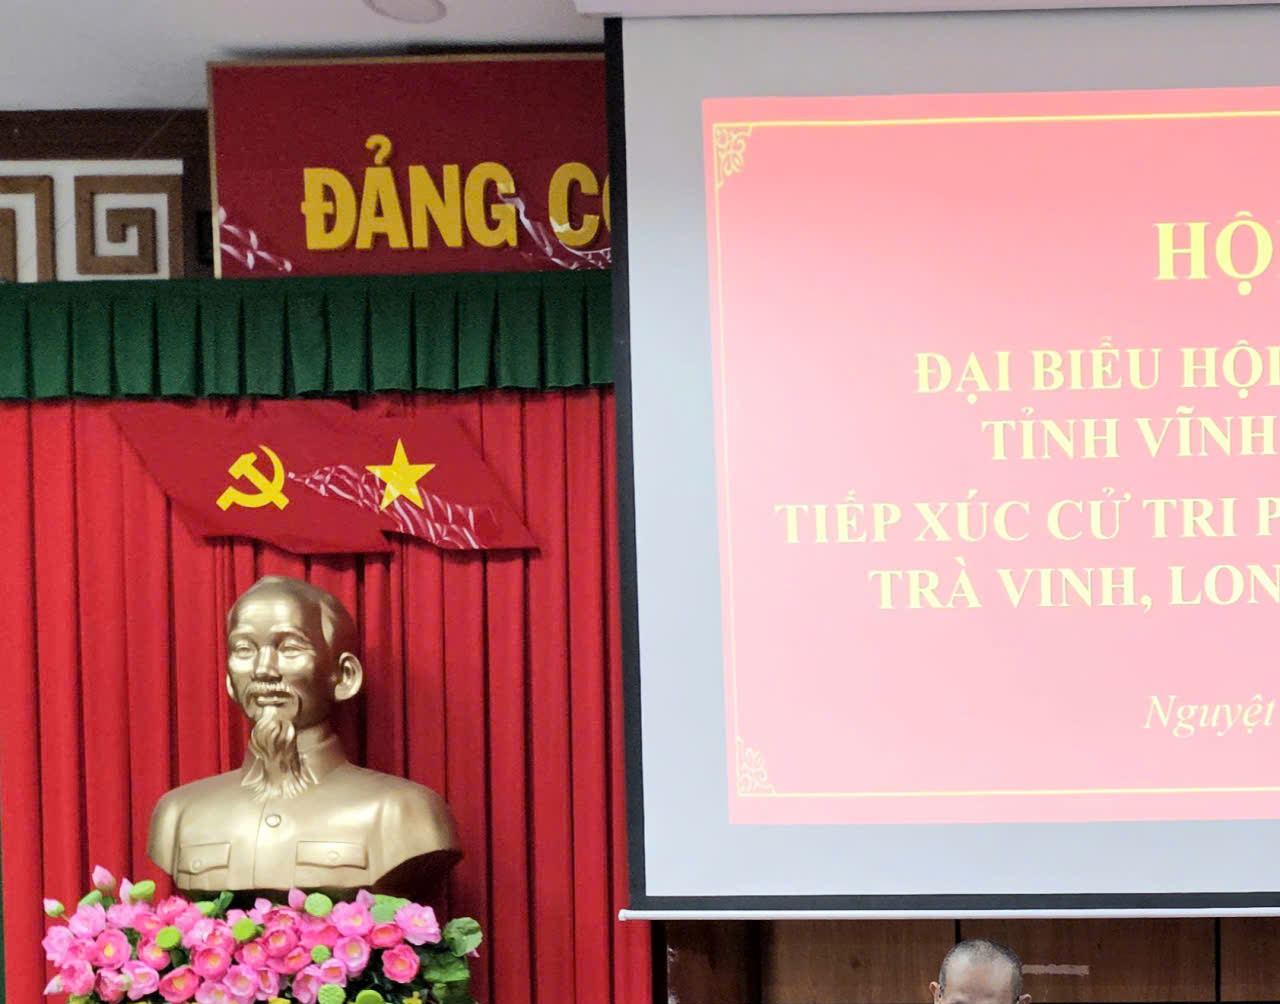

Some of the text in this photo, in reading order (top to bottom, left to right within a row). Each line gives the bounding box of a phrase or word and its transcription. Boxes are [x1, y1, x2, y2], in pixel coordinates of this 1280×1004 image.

[301, 134, 611, 253] ĐẢNG C
[913, 349, 1013, 405] ĐẠI
[1030, 335, 1161, 391] BIỂU
[980, 405, 1121, 461] TỈNH
[1135, 405, 1278, 457] VĨNH
[774, 488, 902, 545] TIẾP
[913, 488, 1030, 543] XÚC
[1046, 486, 1131, 541] CỬ
[1143, 496, 1238, 540] TRI
[868, 556, 983, 610] TRÀ
[997, 565, 1153, 614] VINH,
[1143, 692, 1277, 738] Nguyệt
